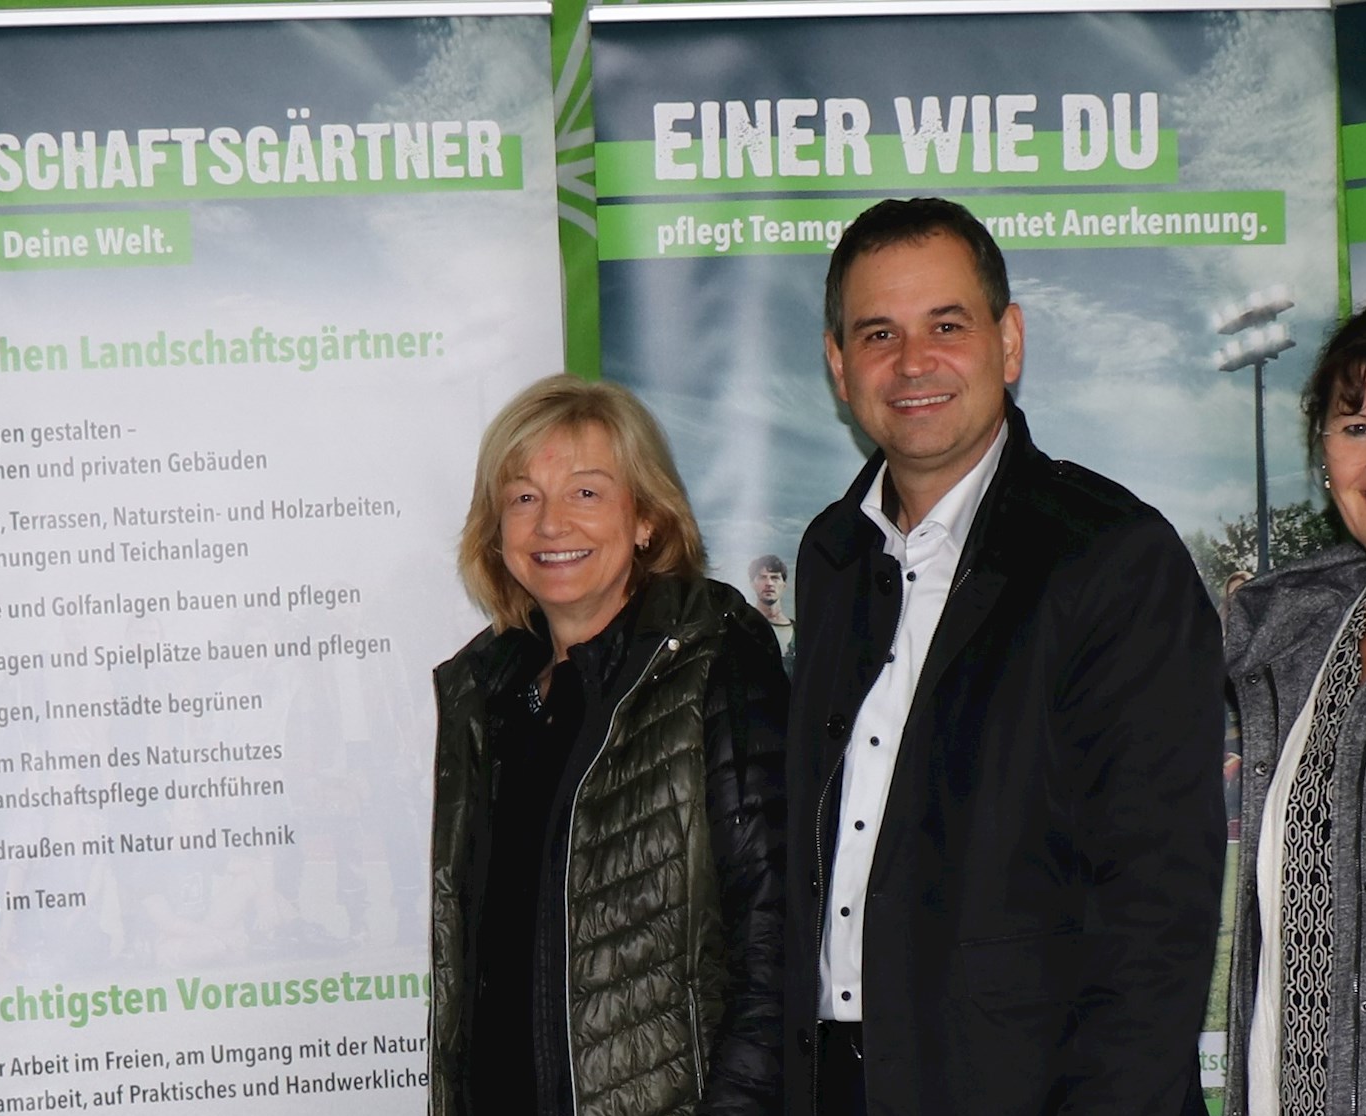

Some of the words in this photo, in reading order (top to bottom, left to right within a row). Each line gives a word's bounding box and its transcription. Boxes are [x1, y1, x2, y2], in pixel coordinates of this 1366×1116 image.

[653, 97, 872, 181] EINER
[895, 92, 1039, 175] WIE
[1062, 92, 1160, 171] DU
[4, 229, 88, 257] Deine
[96, 226, 172, 254] Welt.
[657, 215, 744, 254] pflegt
[1062, 206, 1267, 241] Anerkennung.
[81, 328, 443, 372] Landschaftsgärtner:
[31, 421, 120, 447] gestalten
[37, 457, 73, 477] und
[82, 457, 160, 481] privaten
[168, 451, 266, 471] Gebäuden
[9, 512, 106, 530] Terrassen,
[114, 504, 220, 525] Naturstein-
[228, 500, 264, 521] und
[272, 498, 400, 518] Holzarbeiten,
[79, 543, 114, 563] und
[120, 540, 248, 563] Teichanlagen
[8, 598, 44, 618] und
[53, 594, 169, 618] Golfanlagen
[177, 591, 236, 610] bauen
[244, 587, 280, 607] und
[288, 586, 360, 610] pflegen
[51, 647, 87, 667] und
[95, 644, 200, 670] Spielplätze
[208, 641, 267, 659] bauen
[275, 637, 310, 657] und
[319, 635, 390, 660] pflegen
[46, 696, 161, 718] Innenstädte
[169, 693, 261, 717] begrünen
[21, 752, 100, 770] Rahmen
[108, 748, 140, 767] des
[147, 743, 281, 764] Naturschutzes
[165, 777, 283, 799] durchführen
[83, 836, 114, 854] mit
[121, 835, 173, 852] Natur
[180, 829, 216, 849] und
[222, 826, 294, 847] Technik
[7, 892, 30, 910] im
[35, 890, 85, 908] Team
[11, 1056, 68, 1075] Arbeit
[75, 1054, 98, 1071] im
[106, 1050, 169, 1069] Freien,
[176, 1051, 204, 1065] am
[212, 1046, 292, 1067] Umgang
[300, 1039, 330, 1058] mit
[337, 1037, 367, 1056] der
[94, 1085, 122, 1106] auf
[130, 1081, 236, 1102] Praktisches
[244, 1076, 278, 1096] und
